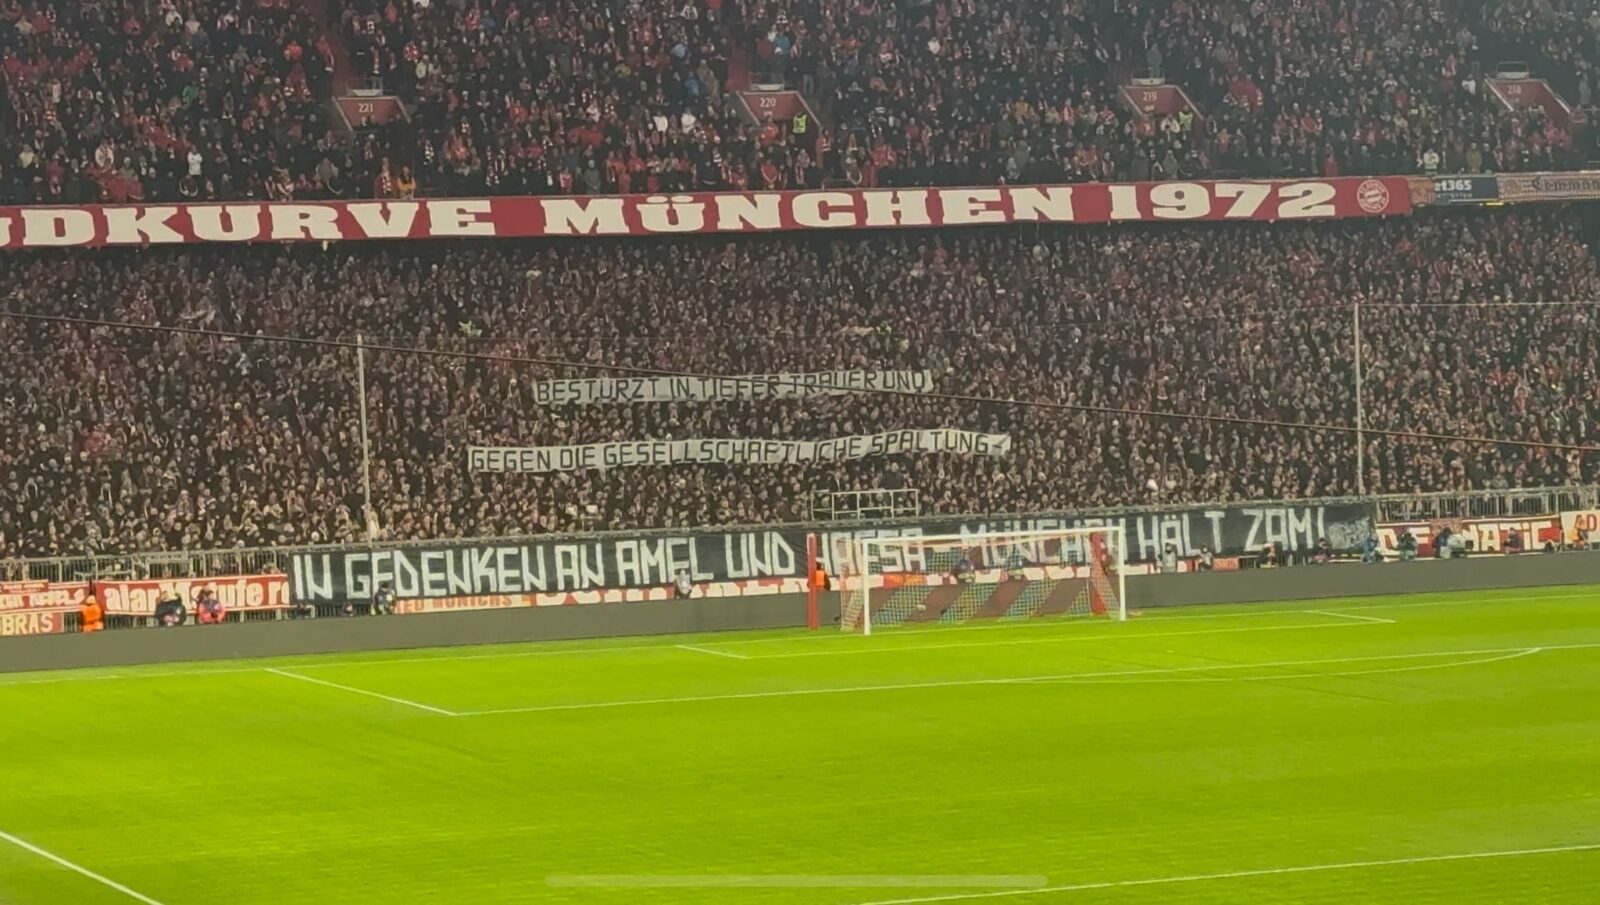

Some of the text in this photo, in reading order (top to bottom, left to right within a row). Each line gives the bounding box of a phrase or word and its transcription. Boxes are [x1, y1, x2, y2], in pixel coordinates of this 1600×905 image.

[358, 103, 374, 113] 221
[760, 97, 776, 108] 220
[1143, 91, 1157, 102] 219
[0, 199, 496, 248] DKURVE
[540, 186, 1077, 234] MÜNCHEN
[1108, 182, 1337, 219] 1972
[669, 377, 691, 398] IN
[883, 370, 926, 389] UND
[471, 449, 551, 473] GEGEN
[559, 446, 597, 469] DIE
[603, 436, 863, 467] GESELLSCHAFTLICHE
[293, 553, 334, 600] IN
[344, 545, 547, 600] GEDENKEN
[555, 542, 605, 591] AN
[616, 536, 715, 587] AMEL
[725, 531, 796, 579] UND
[1137, 510, 1225, 561] HÄLT
[0, 611, 54, 636] BRAS
